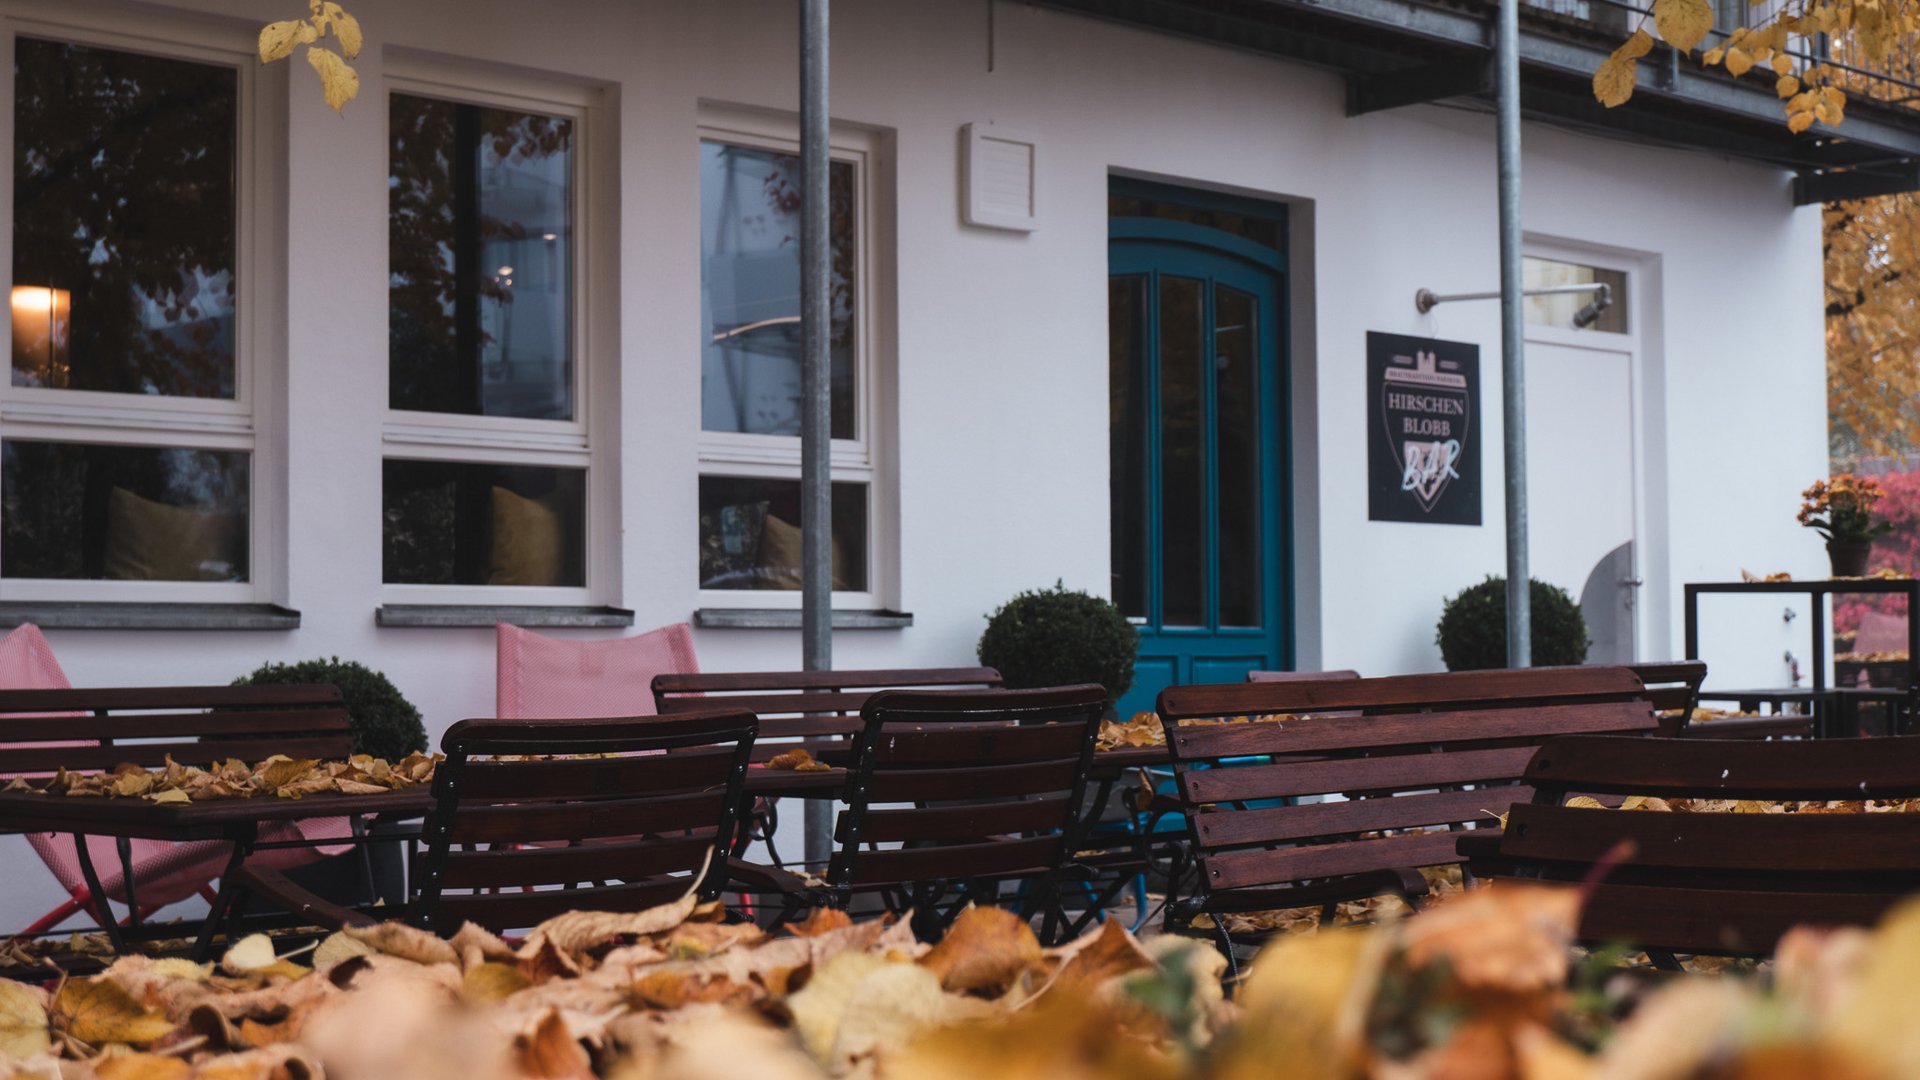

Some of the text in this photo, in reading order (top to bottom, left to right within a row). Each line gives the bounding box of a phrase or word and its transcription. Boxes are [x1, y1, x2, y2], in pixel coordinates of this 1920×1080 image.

[1388, 393, 1464, 415] HIRSCHEN
[1403, 418, 1451, 436] BLOBB
[1402, 439, 1461, 490] BAR
